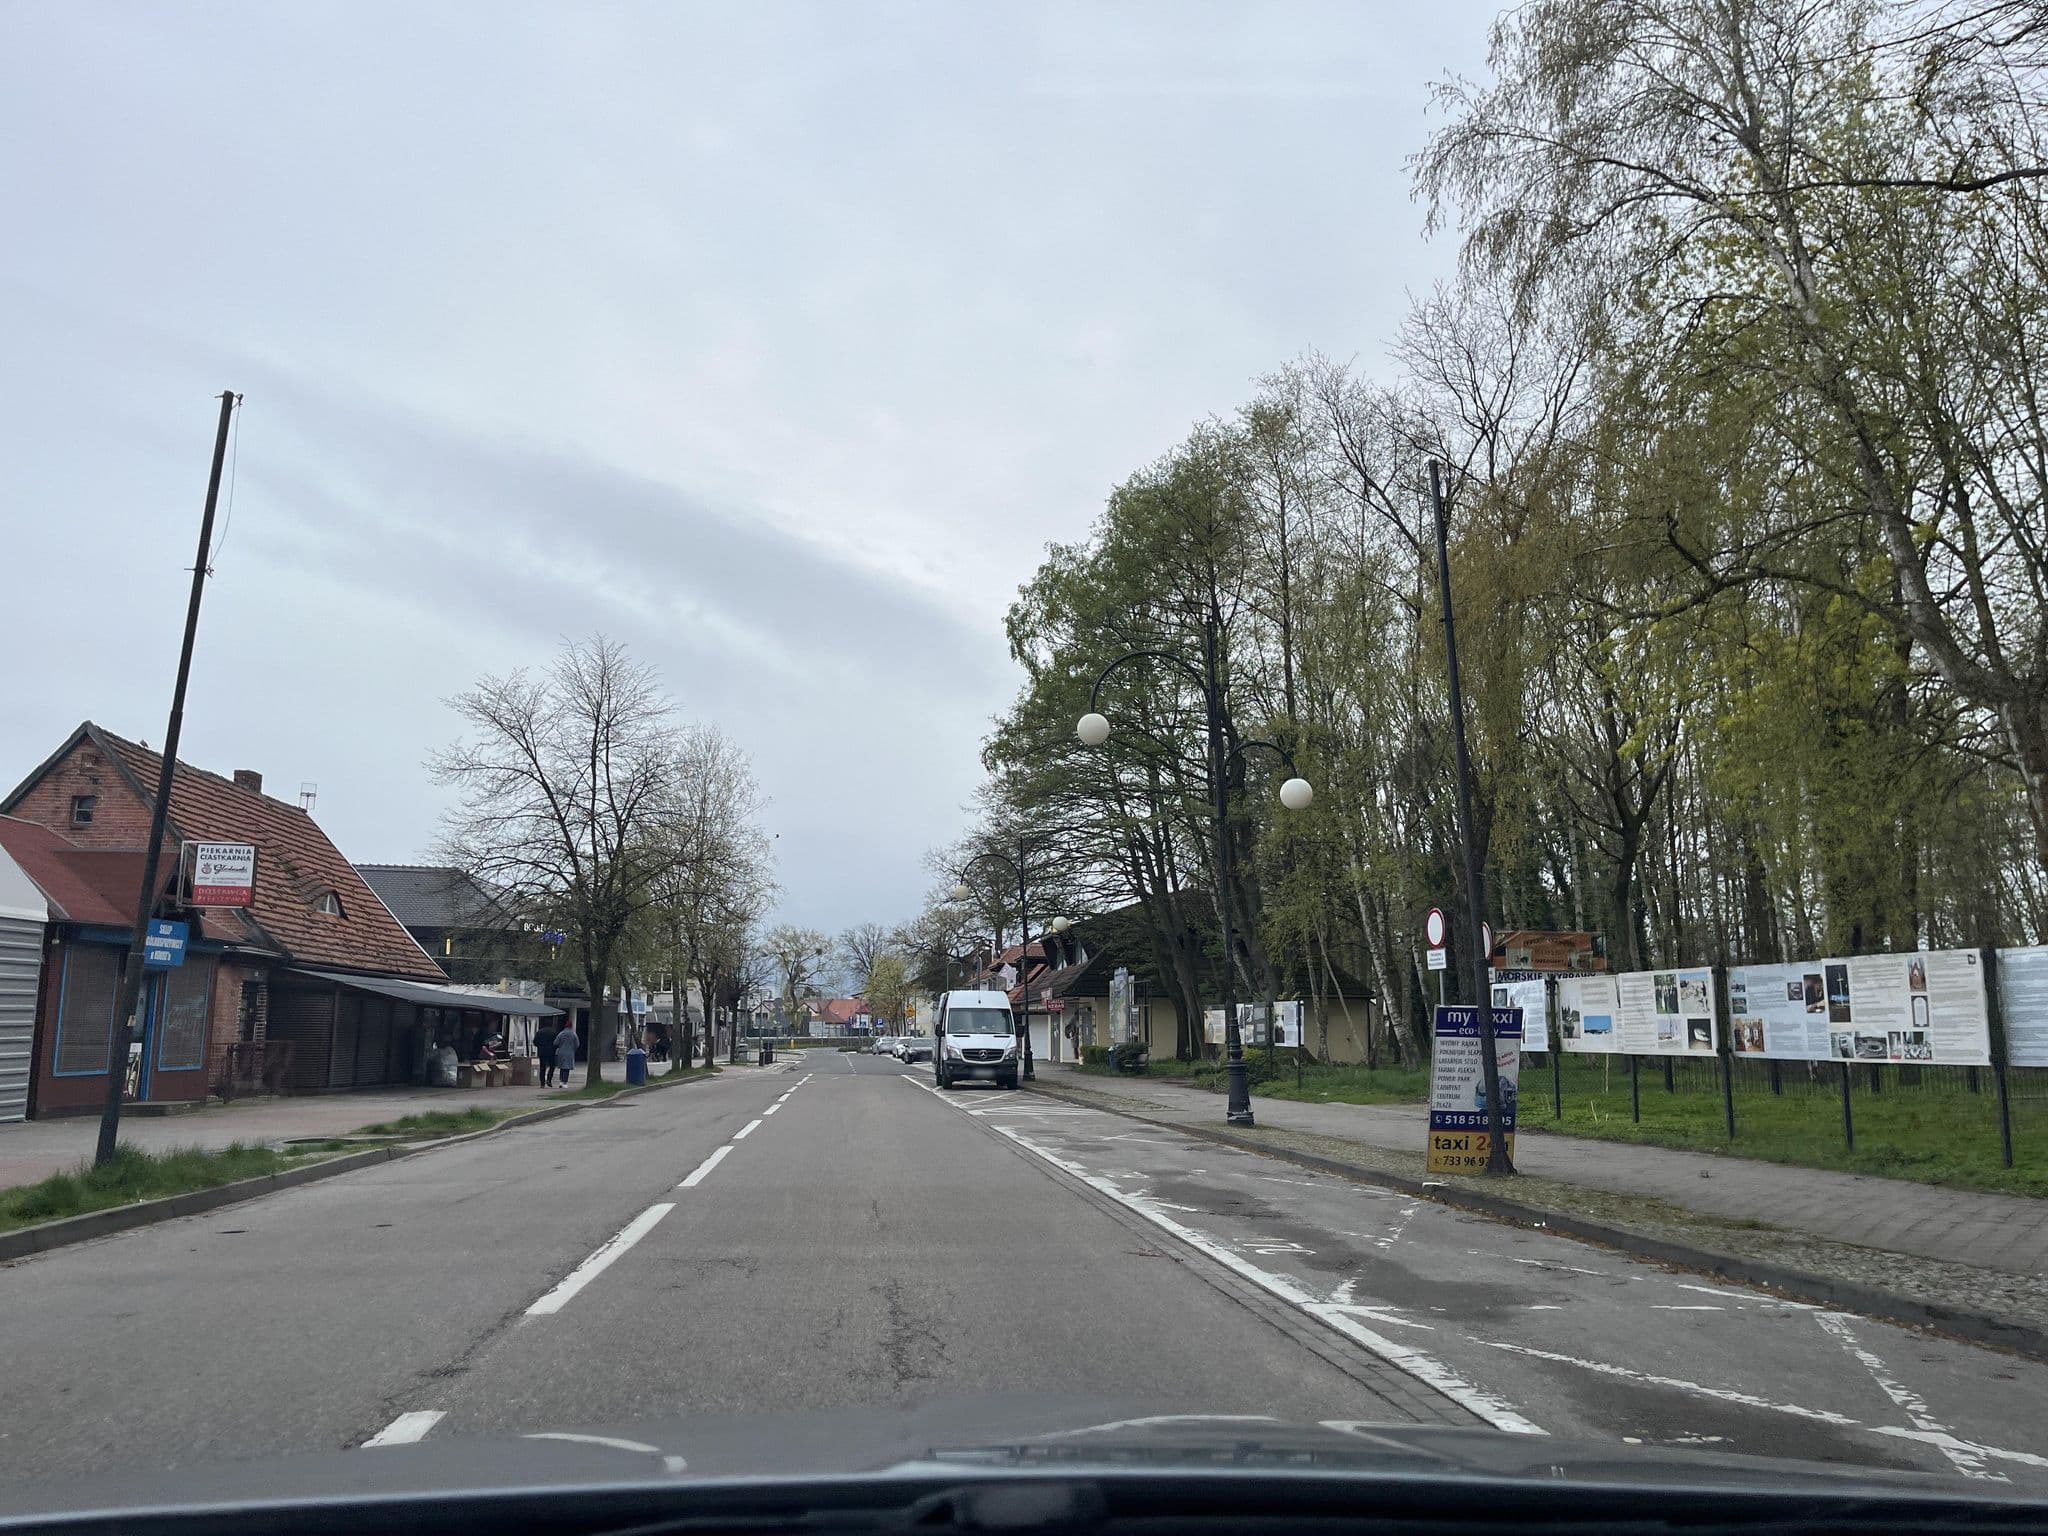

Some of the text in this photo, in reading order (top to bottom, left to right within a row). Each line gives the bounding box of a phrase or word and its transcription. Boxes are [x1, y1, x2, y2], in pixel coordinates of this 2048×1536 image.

[1497, 972, 1543, 982] MORSKIE
[1447, 1010, 1514, 1026] my xxi
[1445, 1115, 1466, 1125] 518
[1468, 1116, 1489, 1125] 518
[1434, 1135, 1469, 1151] taxi
[1443, 1155, 1461, 1166] 733
[1464, 1156, 1475, 1167] 96
